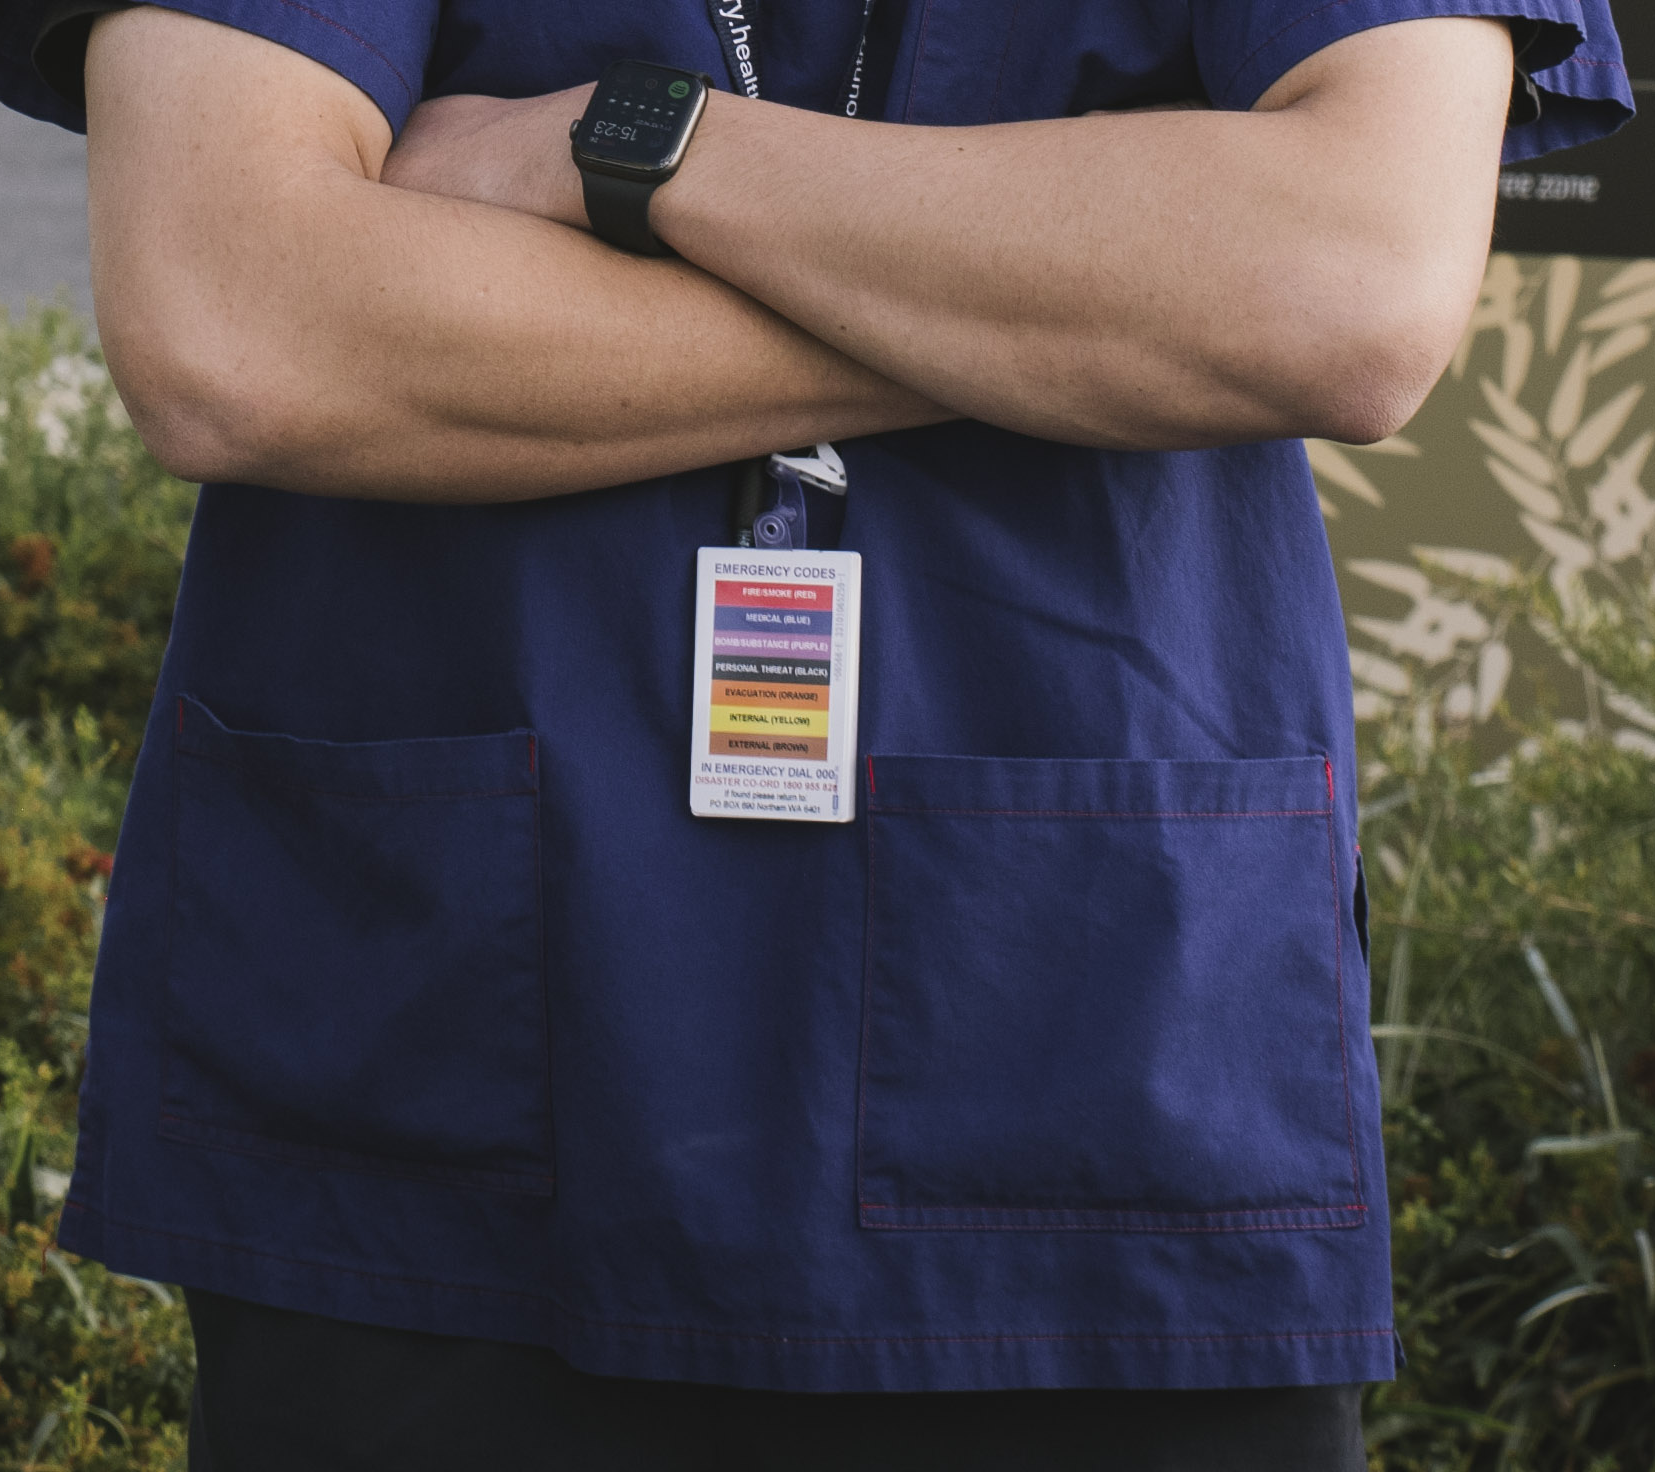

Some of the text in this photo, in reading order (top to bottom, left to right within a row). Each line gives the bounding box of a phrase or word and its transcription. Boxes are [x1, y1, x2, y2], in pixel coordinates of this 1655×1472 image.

[594, 121, 637, 141] 15:23
[714, 563, 836, 579] EMERGENCY CODES
[794, 589, 817, 600] (RED)
[745, 612, 811, 625] MEDICAL (BLUE)
[791, 640, 828, 652] (PURPLE)
[715, 662, 828, 677] PERSONAL THREAT (BLACK)
[725, 688, 818, 702] EVACUATION (ORANGE)
[729, 713, 810, 726] INTERNAL (YELLOW)
[728, 740, 809, 753] EXTERNAL (BROWN)
[701, 762, 835, 780] IN EMERGENCY DIAL 000
[695, 775, 740, 786] DISASTER
[730, 789, 750, 798] found
[752, 790, 775, 800] please
[776, 792, 797, 801] return
[709, 799, 722, 808] PO
[723, 800, 739, 809] BOX
